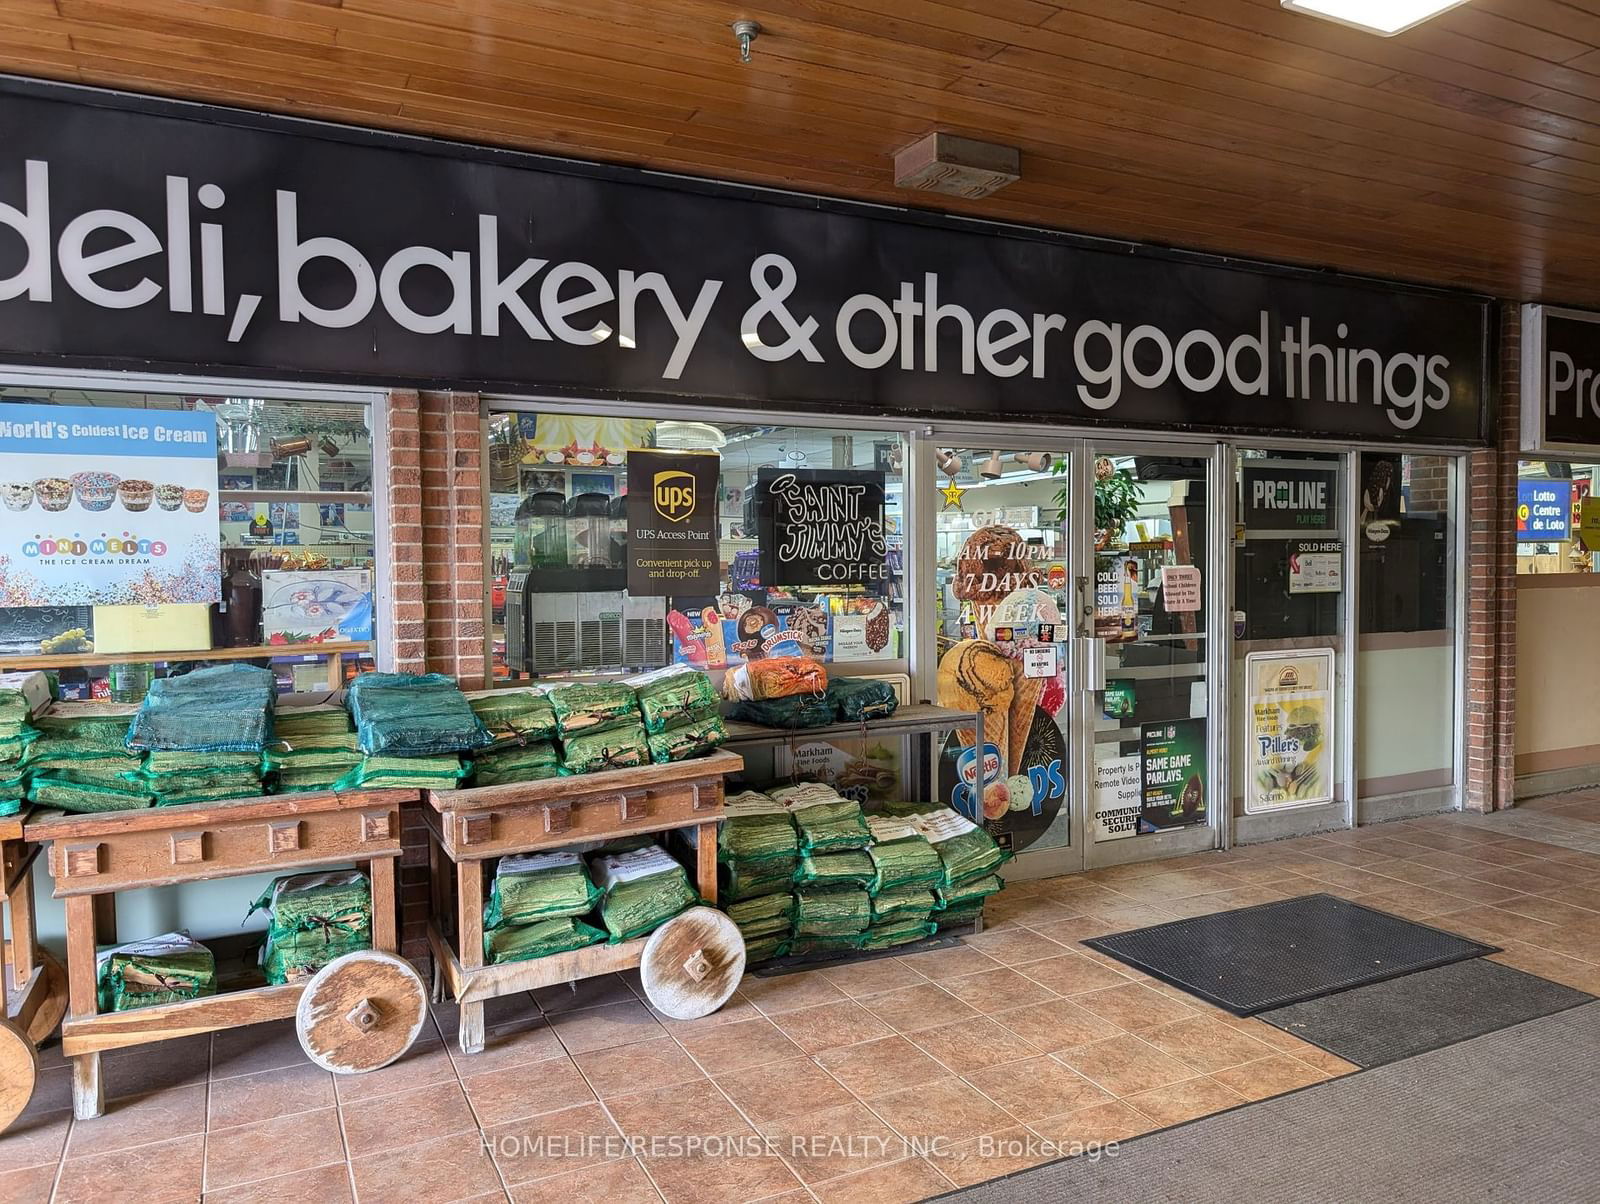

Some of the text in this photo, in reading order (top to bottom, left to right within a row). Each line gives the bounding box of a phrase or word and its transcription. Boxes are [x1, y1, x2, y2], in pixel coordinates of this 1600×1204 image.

[276, 189, 724, 380] bakery
[740, 253, 825, 363] &
[836, 271, 1068, 379] other
[1074, 309, 1270, 410] good
[1281, 316, 1451, 430] things
[71, 424, 121, 438] Coldest
[122, 424, 149, 440] Ice
[153, 425, 208, 444] Cream
[657, 486, 693, 514] ups
[1252, 480, 1327, 509] PROLINE
[1533, 489, 1556, 502] Lotto
[781, 483, 866, 524] SAINT
[1533, 504, 1561, 516] Centre
[1533, 518, 1565, 530] de Loto
[636, 529, 710, 540] UPS Access Point
[779, 517, 888, 562] JIMMY'S
[24, 539, 165, 556] MINI MELTS
[953, 545, 990, 561] AM
[1006, 541, 1055, 560] 10PM
[1298, 542, 1342, 552] SOLD HERE
[636, 558, 713, 570] Convenient pick up
[648, 568, 665, 578] and
[817, 563, 889, 581] COFFEE
[1097, 571, 1119, 582] COLD
[965, 572, 1041, 593] 7 DAYS
[1097, 583, 1118, 593] BEER
[1097, 594, 1119, 605] SOLD
[687, 610, 701, 618] NEW
[777, 607, 791, 615] NEW
[954, 603, 1047, 625] A WEEK
[1097, 606, 1119, 616] HERE
[761, 630, 804, 652] DRUMSTICK
[1258, 735, 1300, 757] Piller's
[1097, 764, 1127, 777] Property
[1127, 763, 1134, 772] Is
[1146, 754, 1192, 771] SAME GAME
[1094, 776, 1140, 790] Remote Video
[1146, 769, 1184, 785] PARLAYS.
